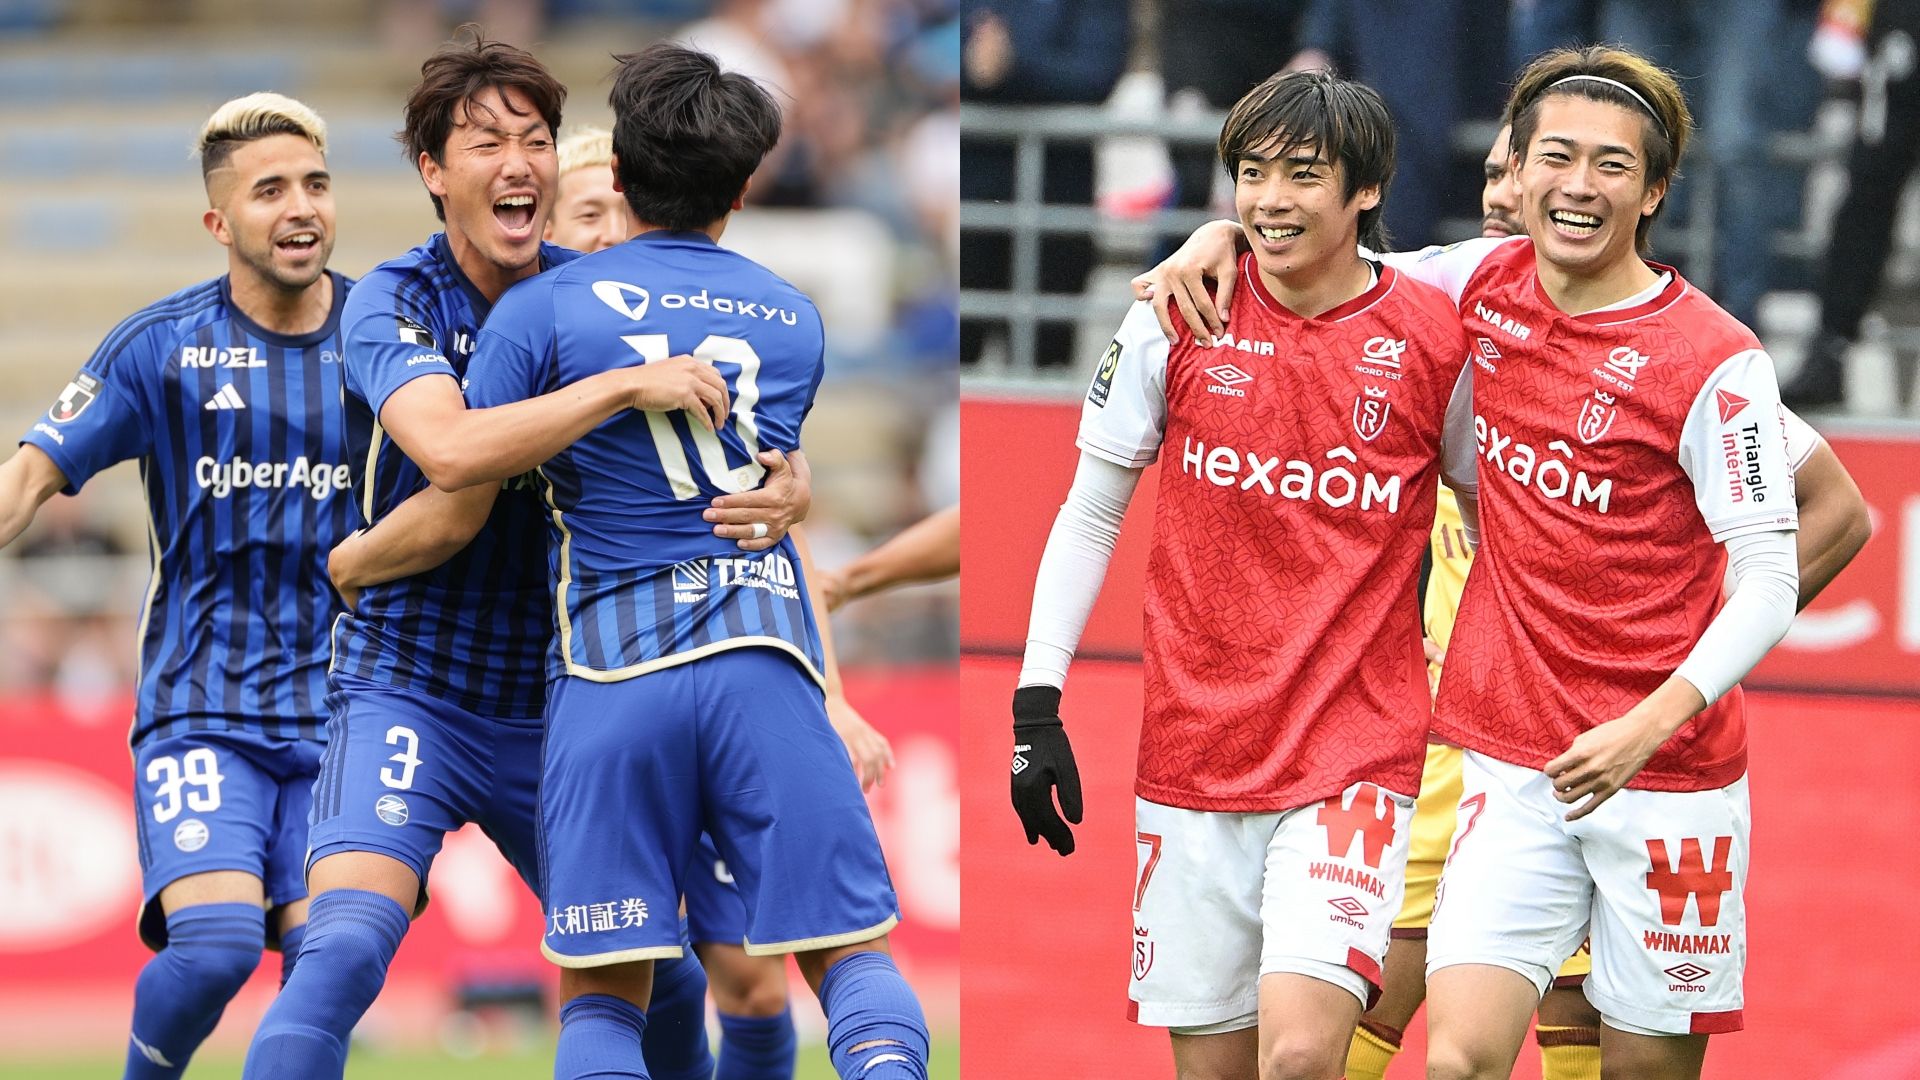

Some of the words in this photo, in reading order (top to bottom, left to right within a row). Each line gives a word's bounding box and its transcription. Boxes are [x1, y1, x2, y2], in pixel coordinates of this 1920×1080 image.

[660, 289, 797, 326] odakyu
[180, 346, 268, 369] RUDEL
[1354, 364, 1384, 377] NORD
[1385, 371, 1403, 381] EST
[1207, 384, 1245, 397] umbro
[1592, 367, 1617, 384] NORD
[1617, 379, 1635, 392] EST
[619, 333, 767, 501] 10
[195, 455, 352, 501] CyberAge
[1722, 432, 1744, 503] intérim
[1742, 422, 1768, 503] Triangle
[379, 725, 424, 790] 3
[146, 747, 225, 824] 39
[1133, 831, 1163, 913] 7
[1308, 861, 1386, 901] WINAMAX
[547, 896, 650, 937] 大和証券
[1330, 914, 1365, 931] umbro
[1643, 929, 1732, 955] WINAMAX
[1668, 982, 1707, 994] umbro
